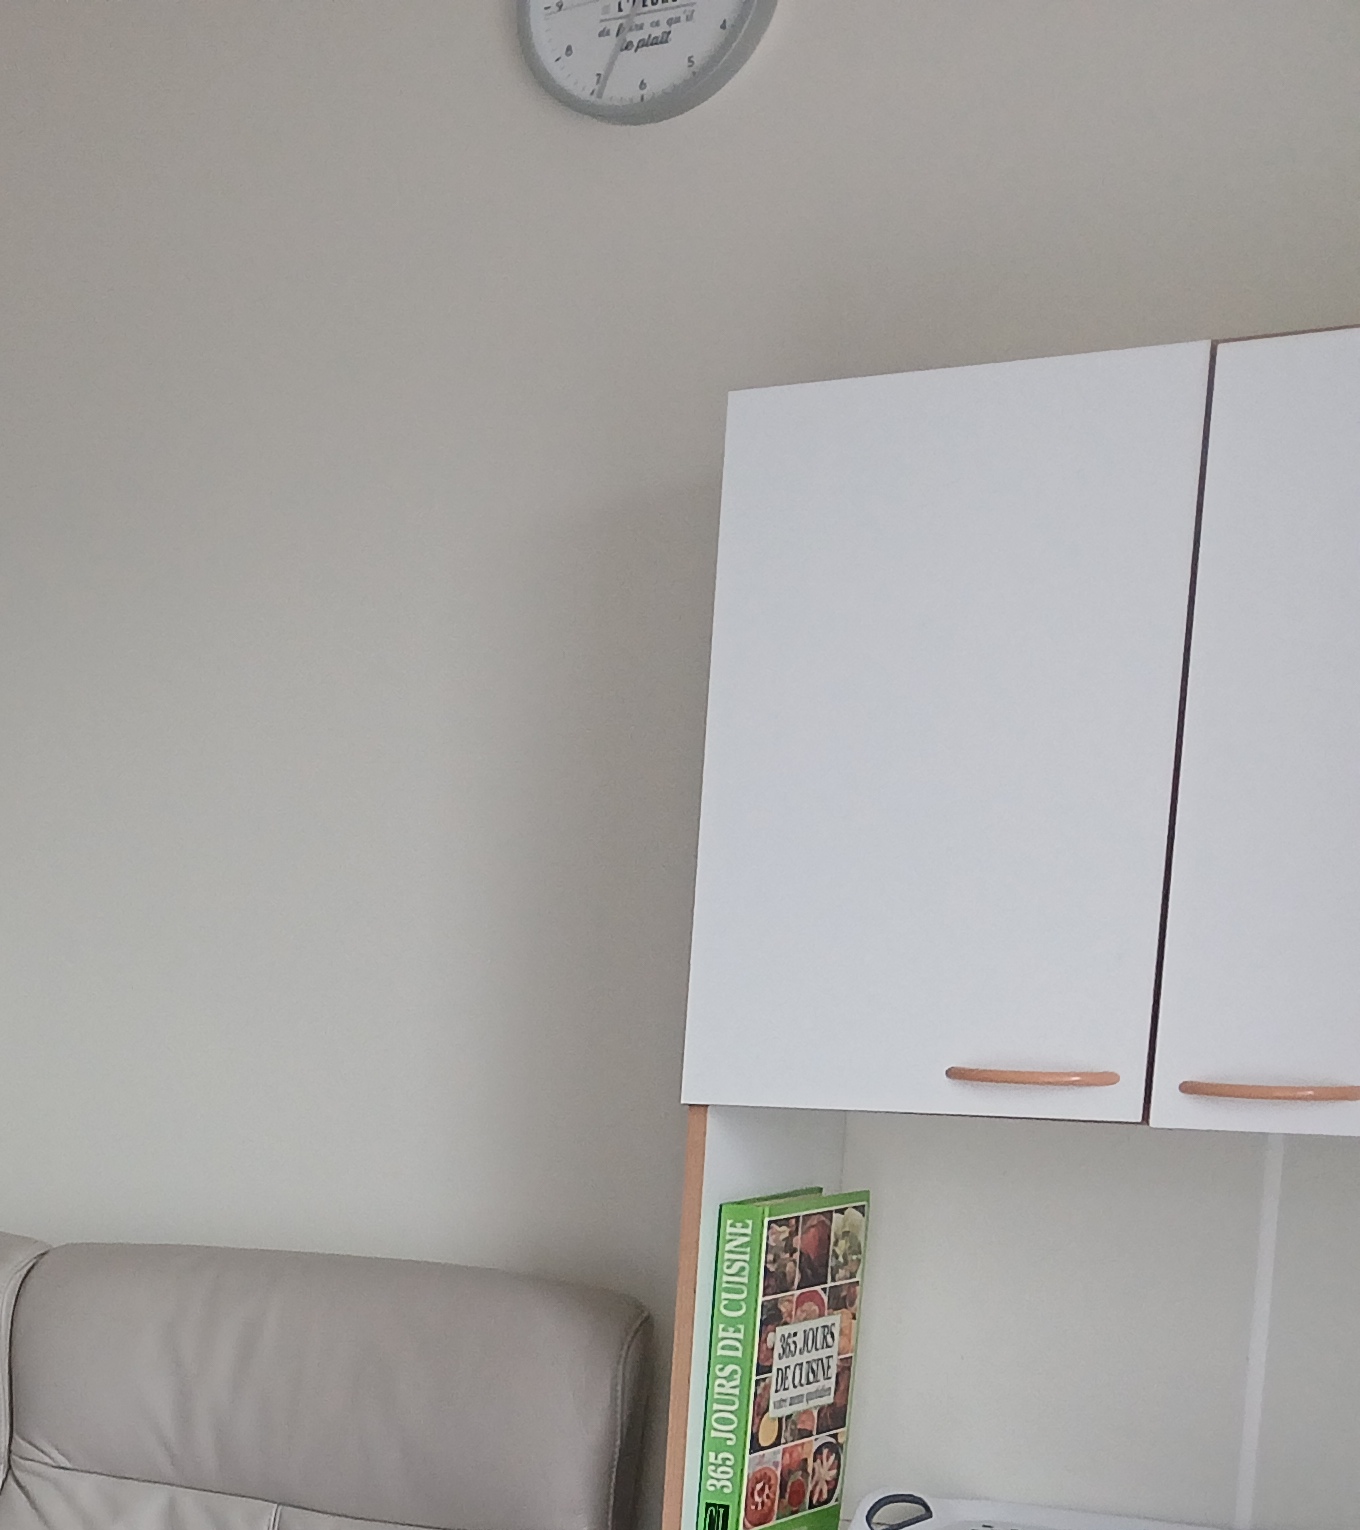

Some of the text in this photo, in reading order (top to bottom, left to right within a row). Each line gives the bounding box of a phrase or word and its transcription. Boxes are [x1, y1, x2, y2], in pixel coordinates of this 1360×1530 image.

[615, 22, 645, 38] fire
[706, 1219, 753, 1494] 365 JOURS DE CUISINE
[778, 1322, 836, 1360] 365 JOURS
[774, 1354, 834, 1394] DE CUISINE
